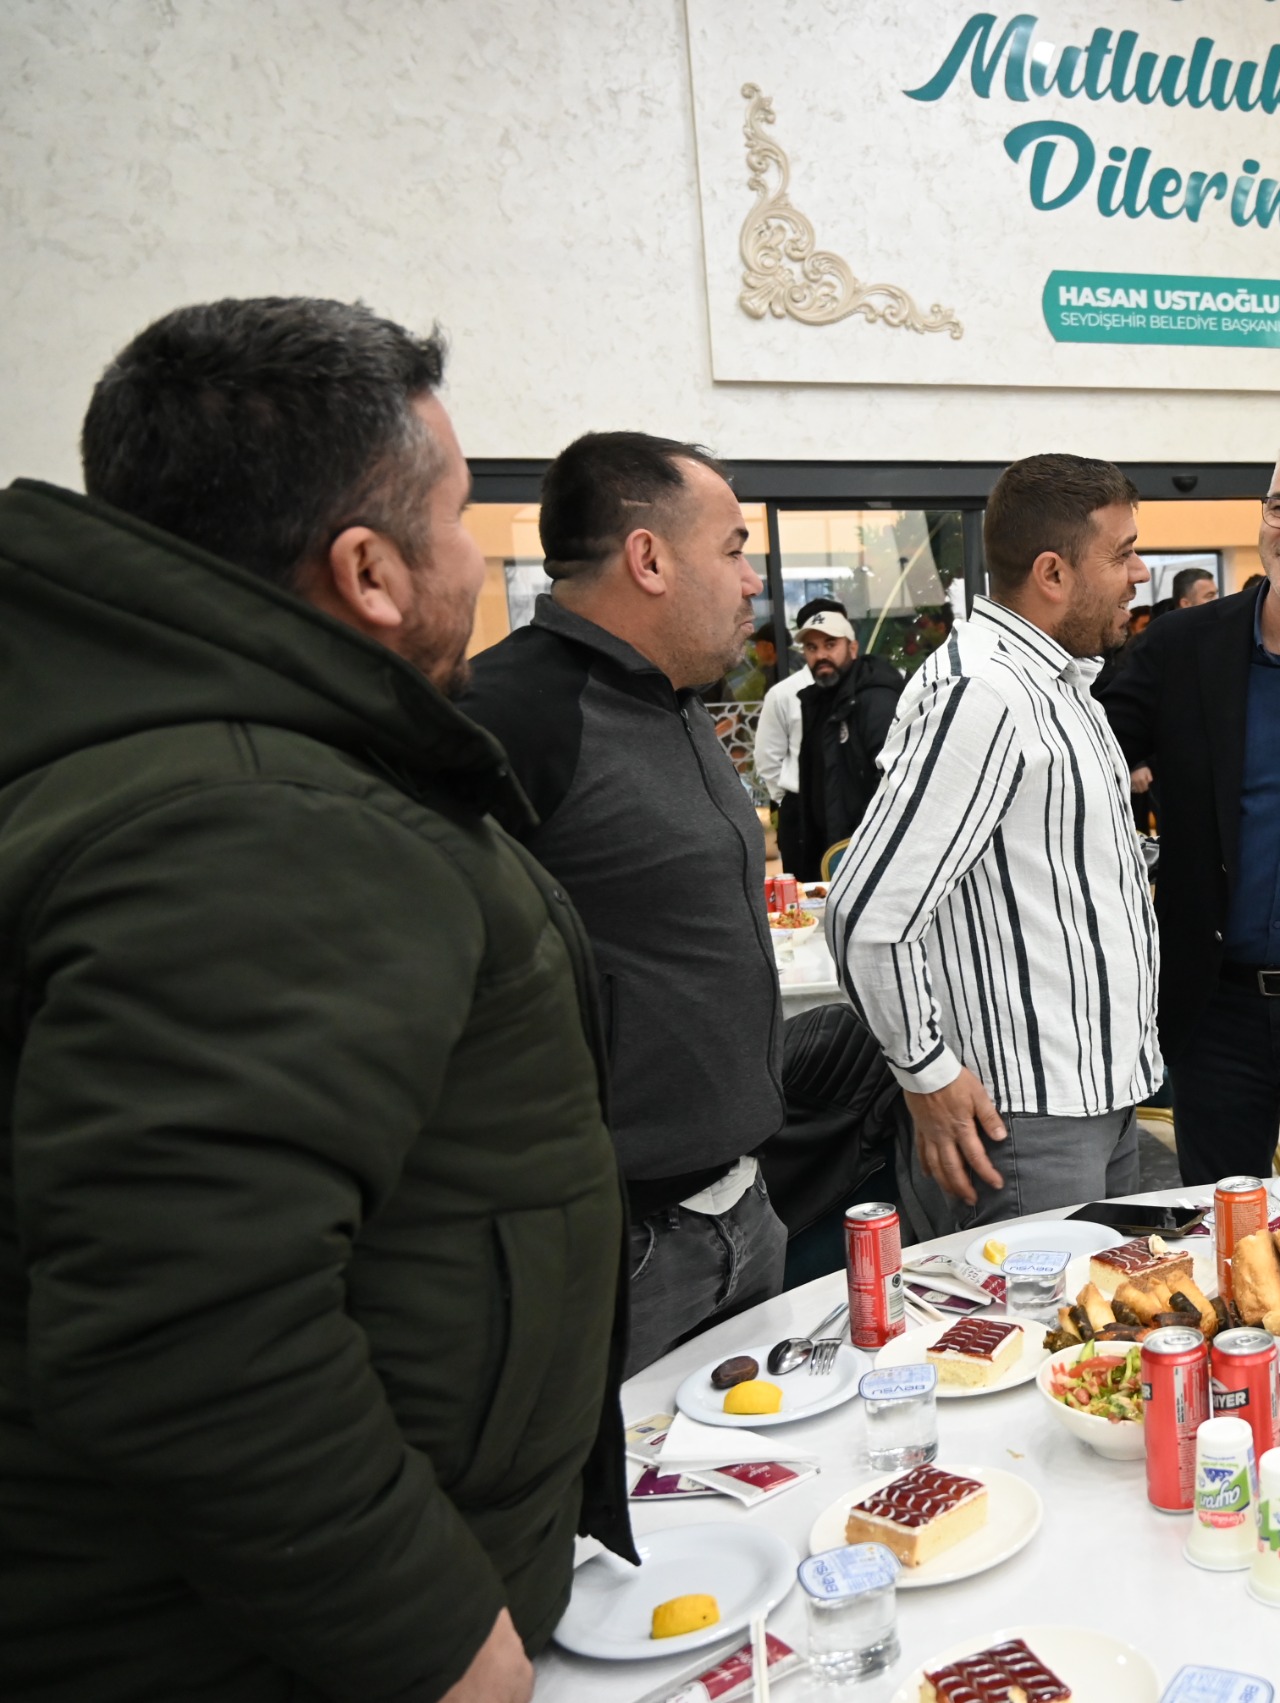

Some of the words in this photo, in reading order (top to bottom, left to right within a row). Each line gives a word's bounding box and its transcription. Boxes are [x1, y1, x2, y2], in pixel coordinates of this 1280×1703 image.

[1059, 286, 1147, 308] HASAN
[1154, 288, 1280, 314] USTAOĞLU
[1061, 311, 1146, 330] SEYDİŞEHİR
[1150, 314, 1218, 331] BELEDİYE
[1221, 318, 1280, 335] BAŞKANI
[1200, 1480, 1241, 1508] ayran
